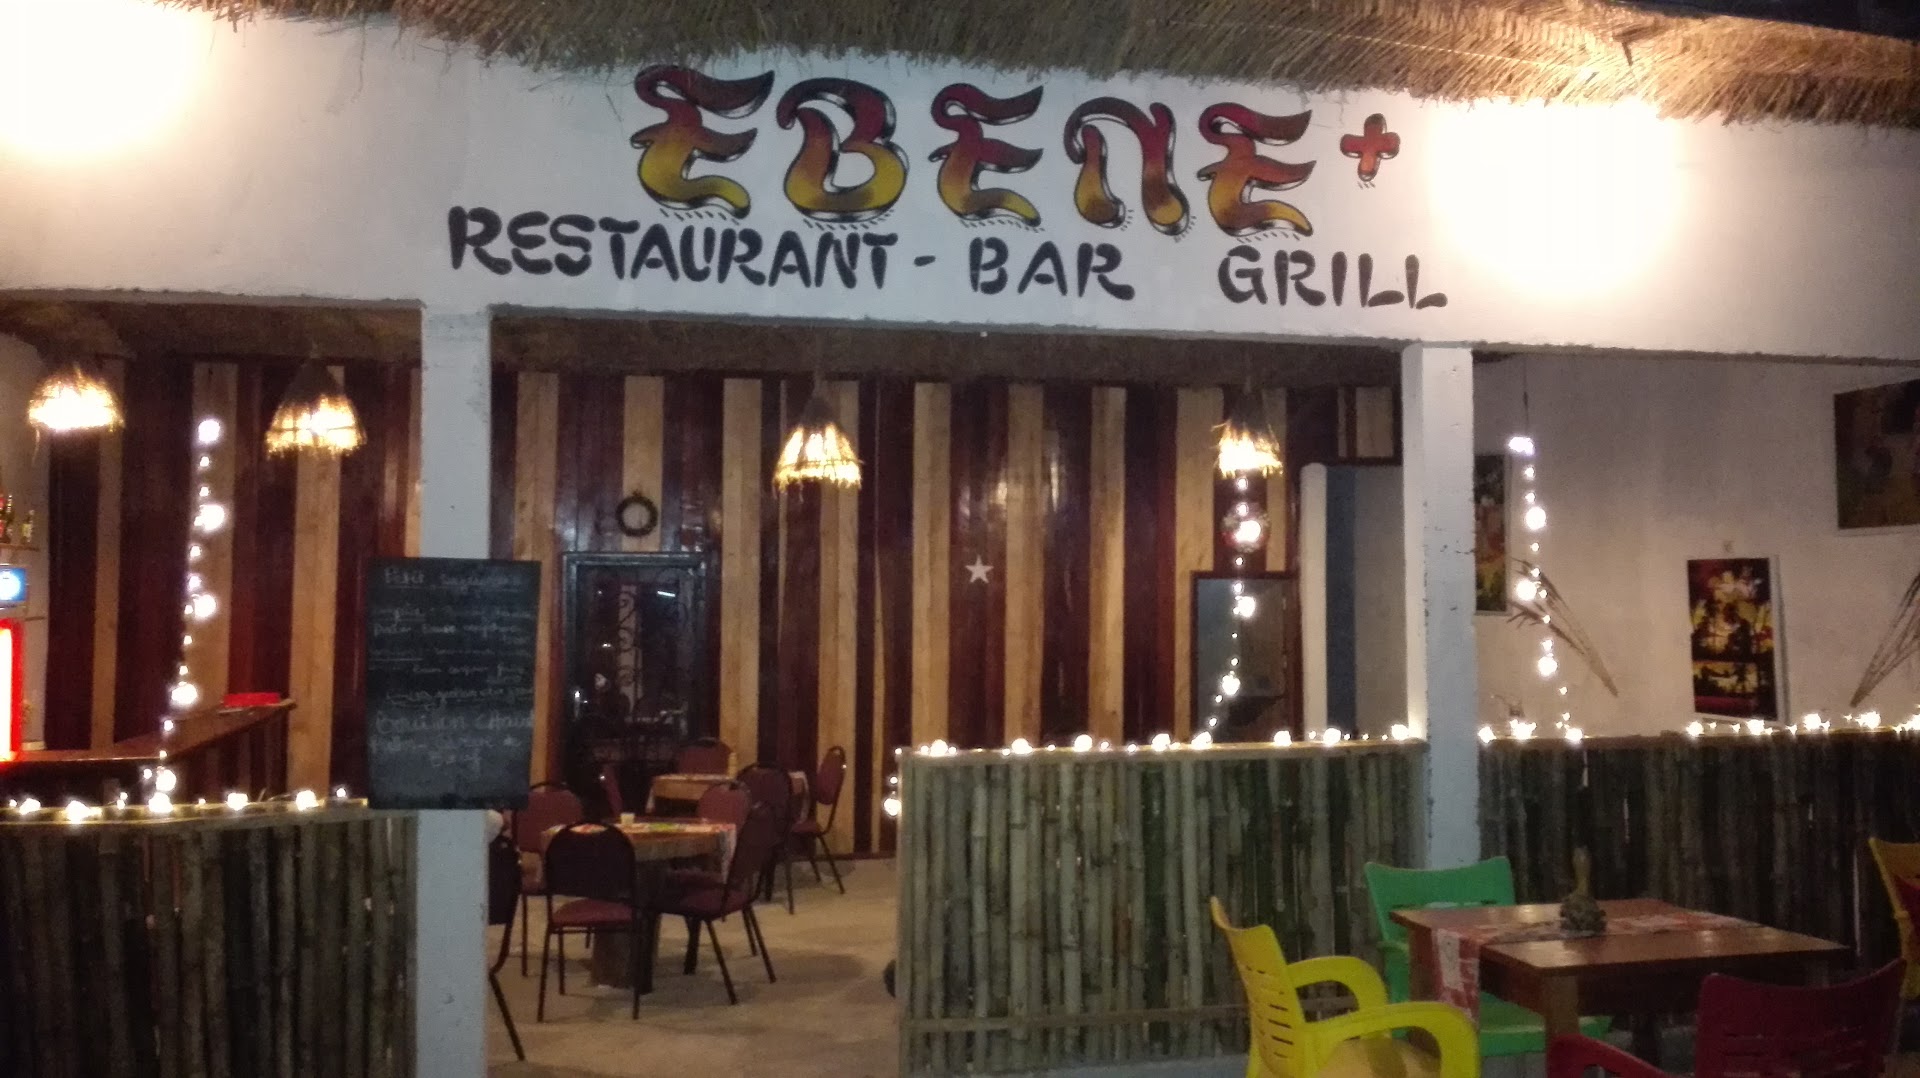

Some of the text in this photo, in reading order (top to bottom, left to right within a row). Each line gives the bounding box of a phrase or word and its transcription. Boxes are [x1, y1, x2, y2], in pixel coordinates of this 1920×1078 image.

[448, 206, 898, 289] RESTAURANT
[968, 237, 1135, 300] BAR
[1217, 245, 1448, 309] GRILL
